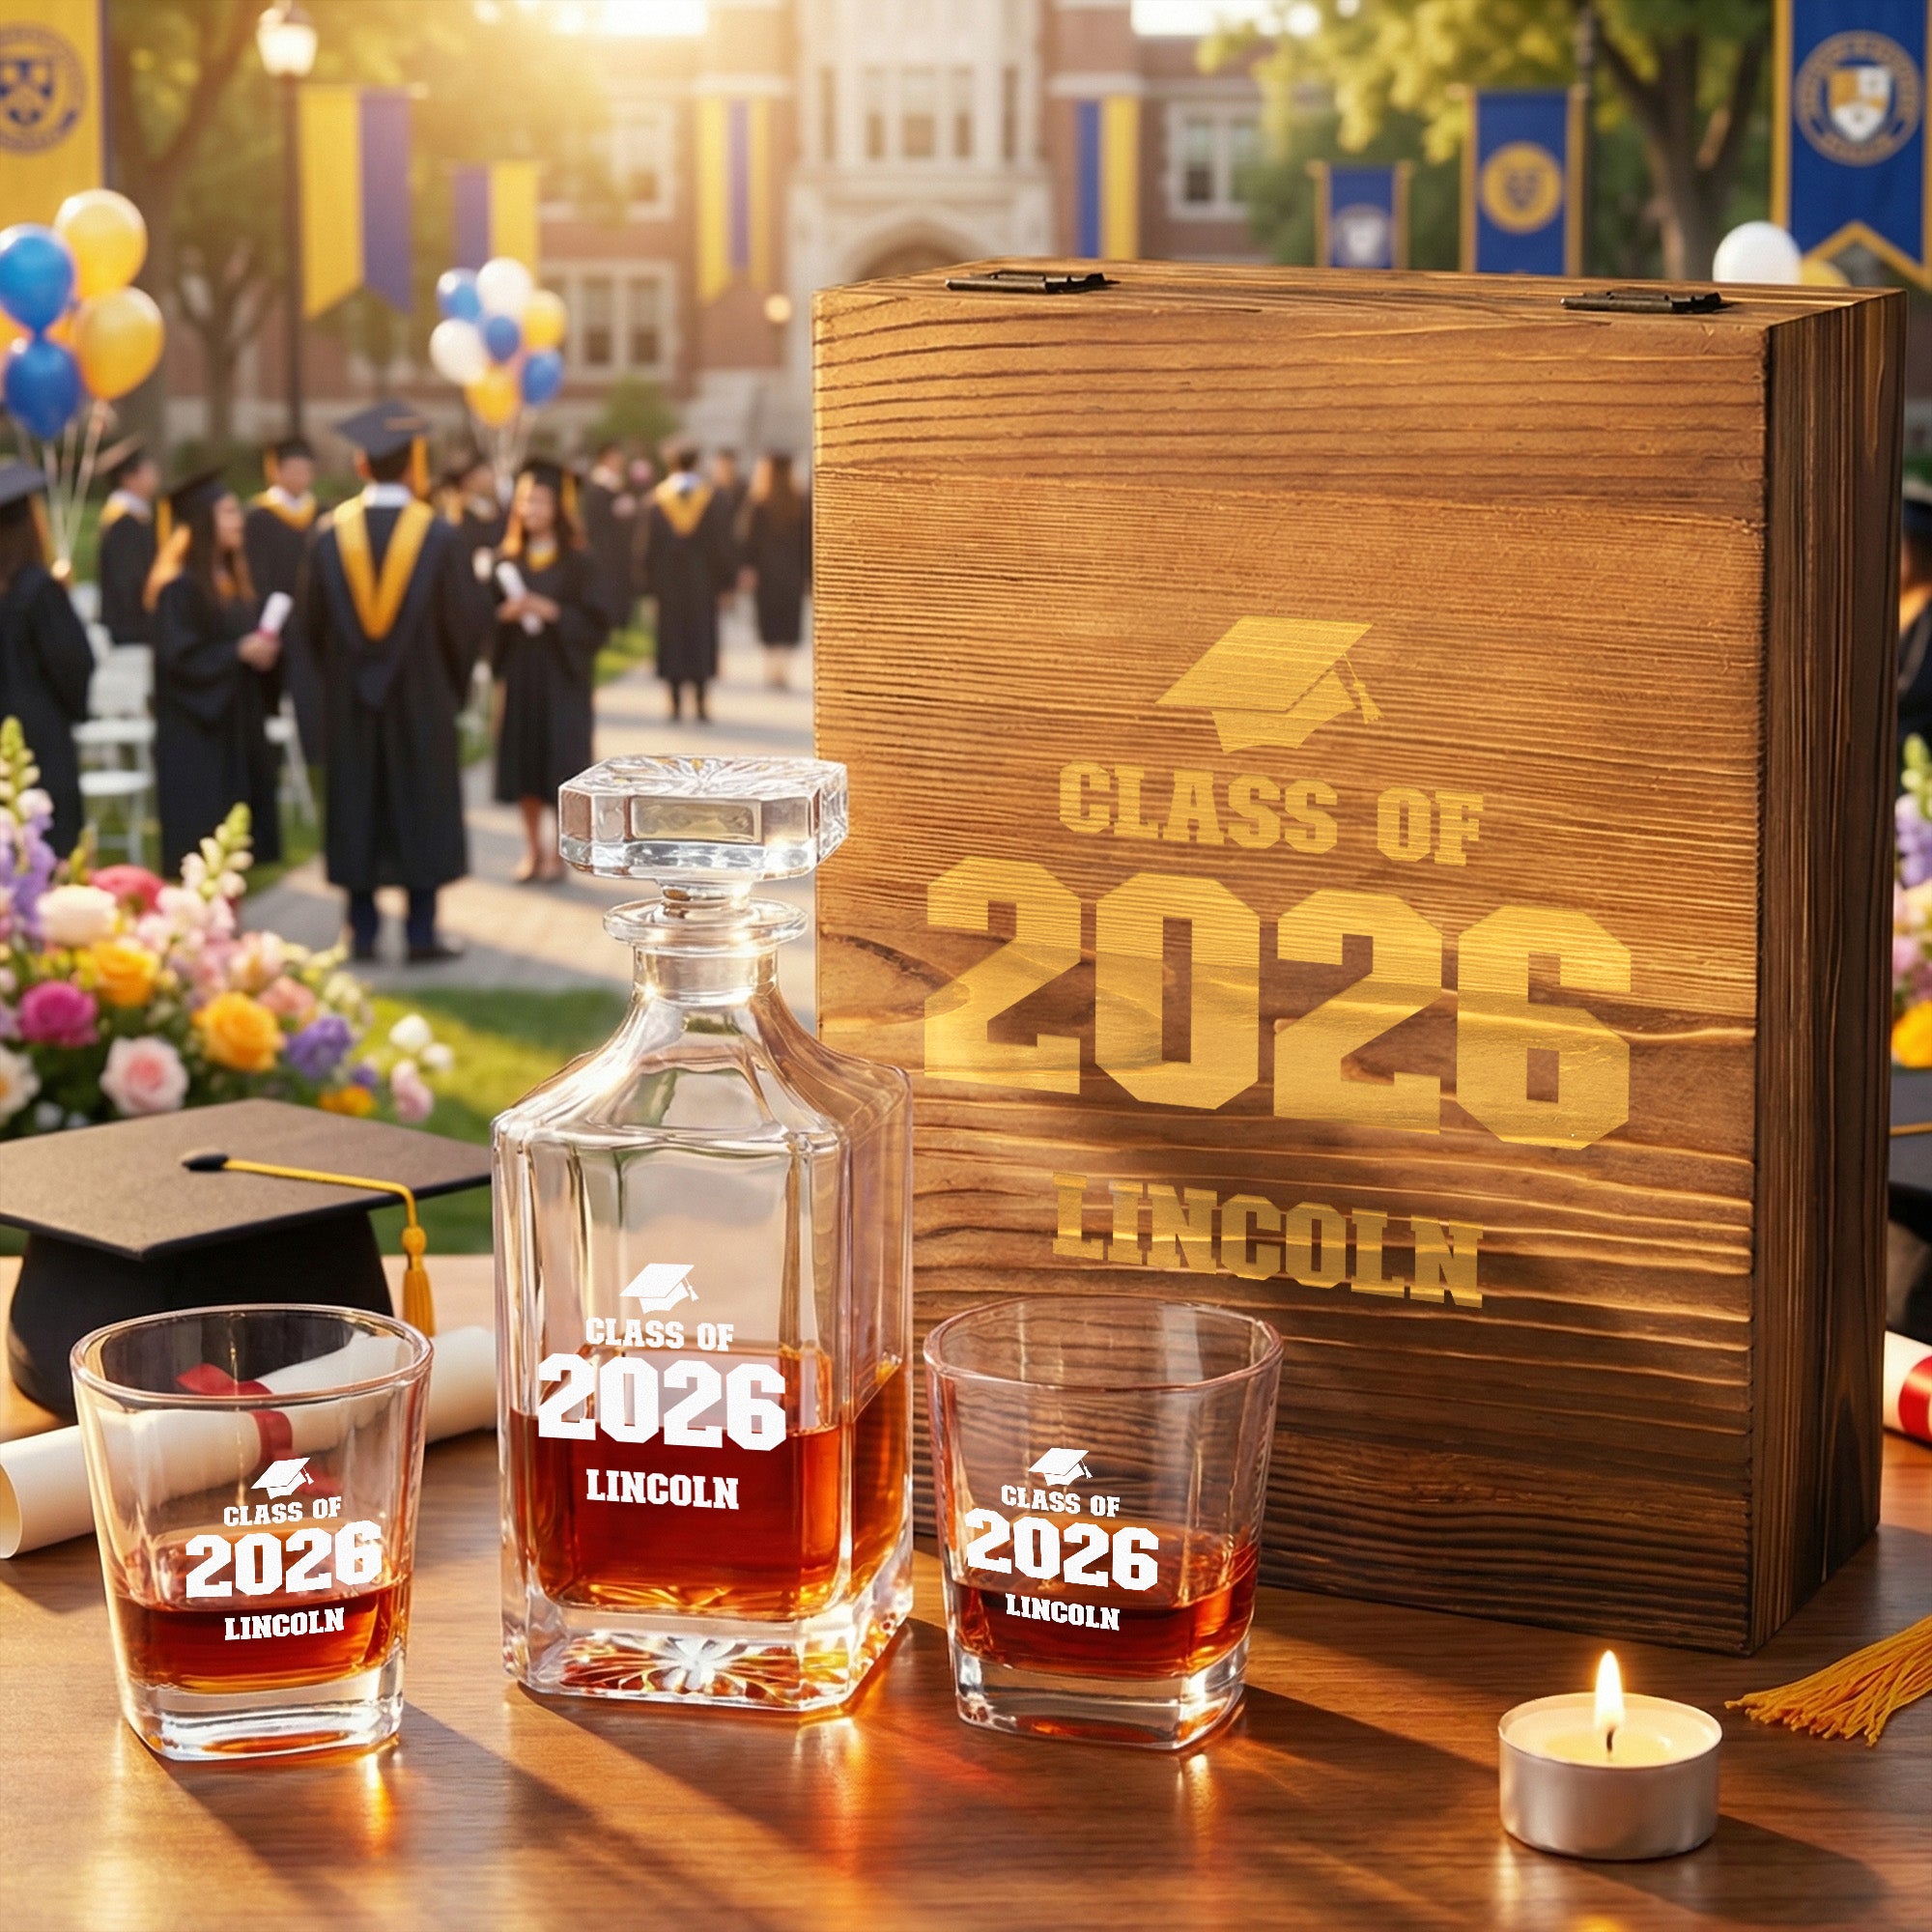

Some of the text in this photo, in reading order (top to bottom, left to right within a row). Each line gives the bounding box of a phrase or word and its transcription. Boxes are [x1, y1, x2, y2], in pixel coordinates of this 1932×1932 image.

[1060, 760, 1484, 866] CLASS OF
[924, 857, 1632, 1151] 2026
[1052, 1172, 1484, 1309] LINCOLN
[585, 1317, 734, 1351] CLASS OF
[538, 1352, 786, 1451] 2026
[223, 1496, 342, 1527] CLASS OF
[585, 1468, 740, 1510] LINCOLN
[1001, 1484, 1121, 1518] CLASS OF
[185, 1520, 383, 1599] 2026
[964, 1508, 1159, 1591] 2026
[224, 1607, 345, 1641] LINCOLN
[1005, 1593, 1121, 1632] LINCOLN
